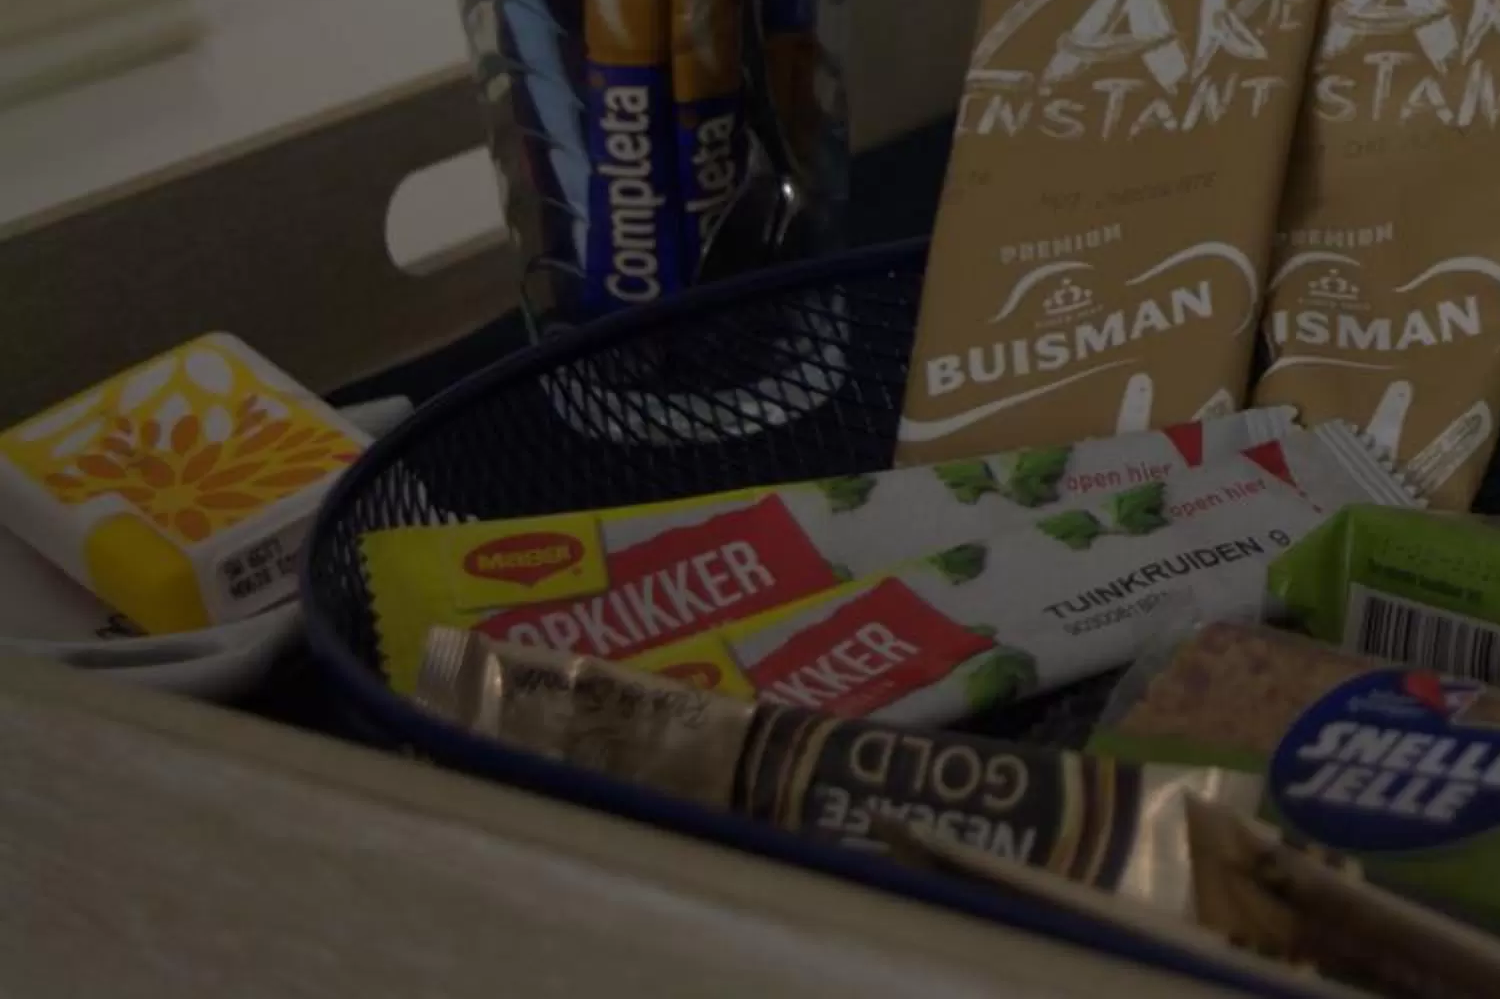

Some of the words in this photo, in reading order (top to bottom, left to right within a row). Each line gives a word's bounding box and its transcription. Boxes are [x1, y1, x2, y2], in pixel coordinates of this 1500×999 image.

[953, 73, 1288, 140] INSTANT
[597, 85, 667, 303] Completa
[925, 280, 1213, 397] BUISMAN
[1271, 295, 1482, 351] ISMAN
[1066, 470, 1121, 493] open
[1126, 461, 1172, 482] hier
[1169, 493, 1222, 519] open
[1223, 478, 1266, 500] hier
[1043, 537, 1265, 619] TUINKRUIDEN
[850, 729, 1030, 813] GOLD
[1284, 761, 1478, 823] JELLE
